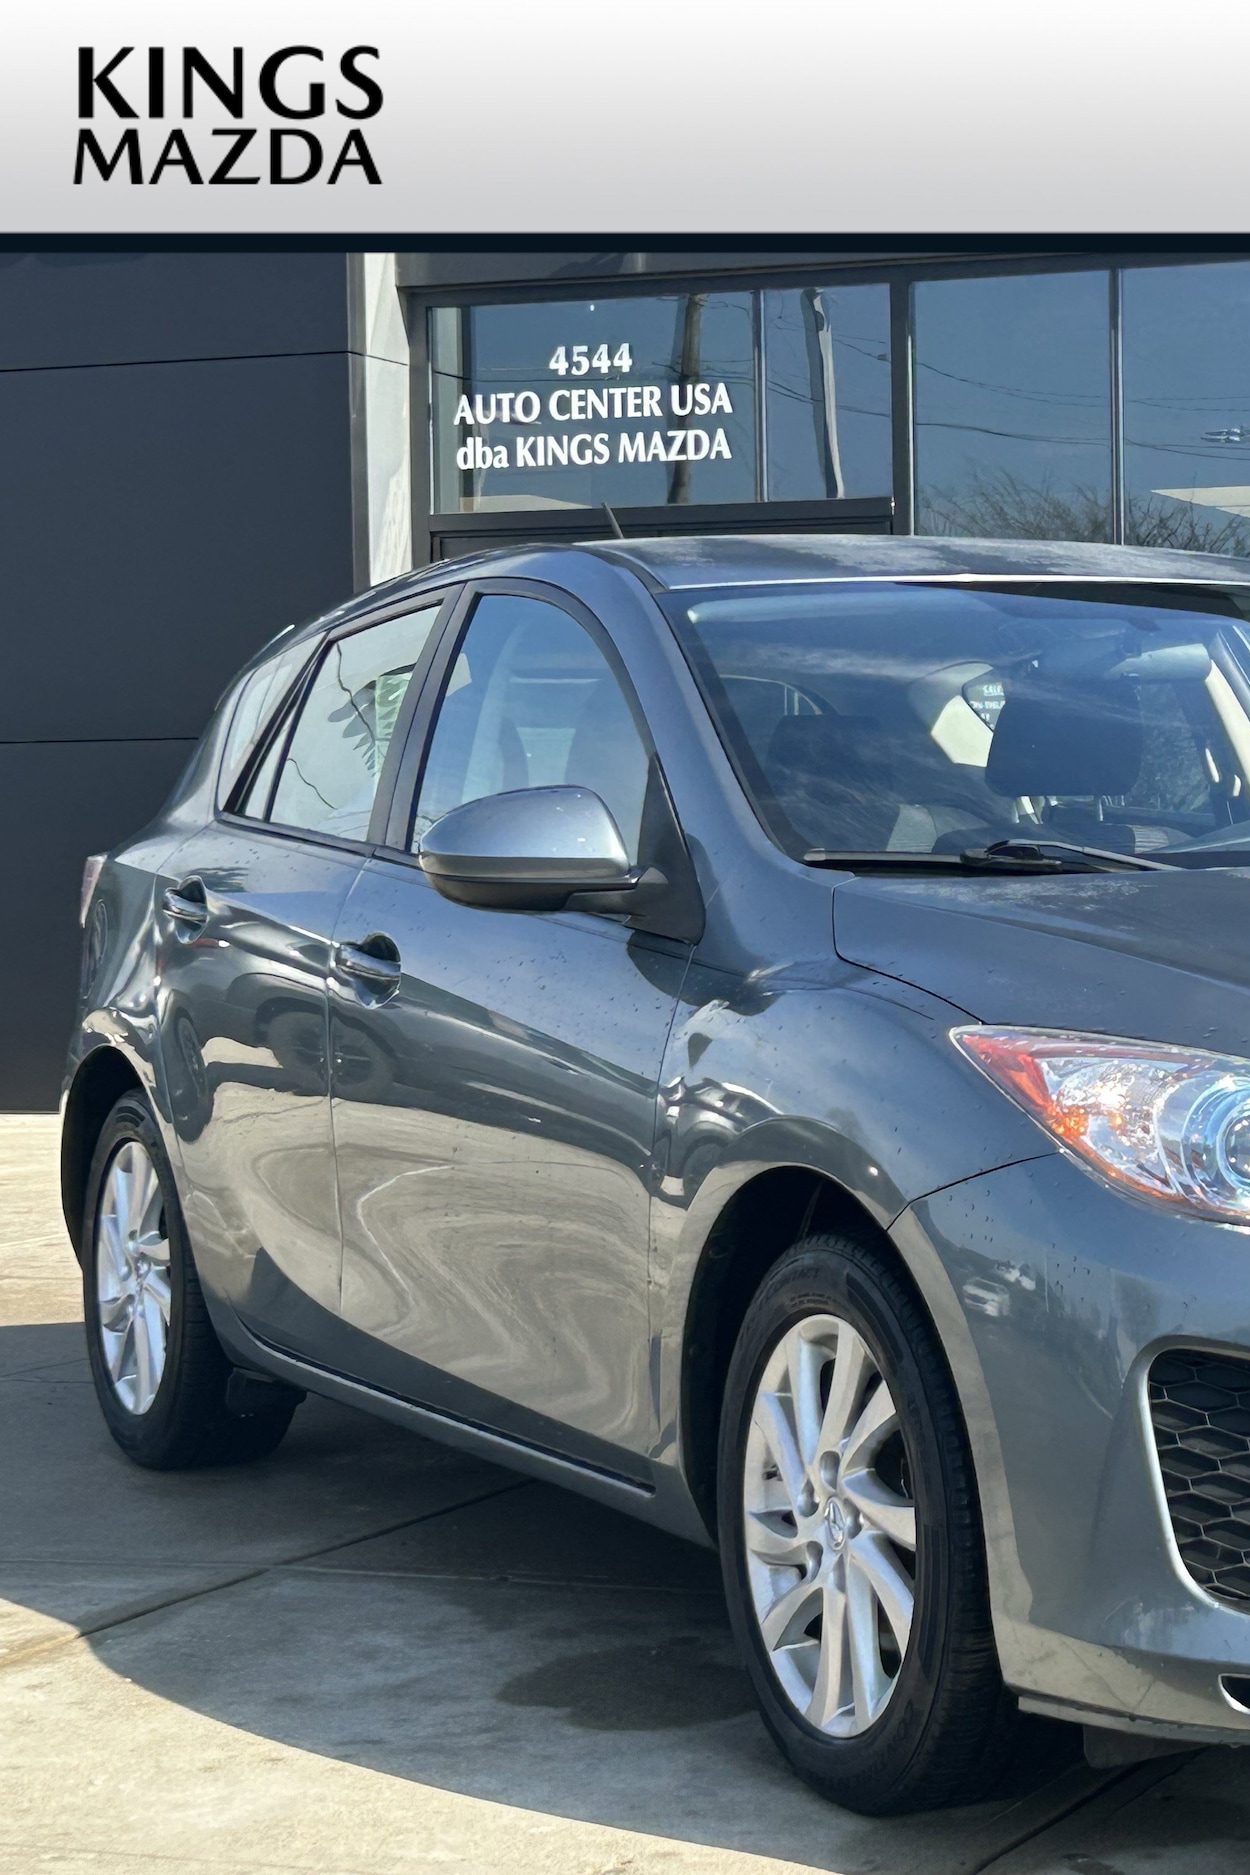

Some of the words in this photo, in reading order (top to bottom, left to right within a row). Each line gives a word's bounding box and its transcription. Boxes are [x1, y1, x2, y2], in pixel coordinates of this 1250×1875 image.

[549, 343, 633, 376] 4544
[453, 391, 541, 426] AUTO
[549, 385, 663, 421] CENTER
[670, 382, 733, 417] USA
[456, 437, 510, 470] dba
[516, 433, 609, 468] KINGS
[618, 428, 733, 463] MAZDA
